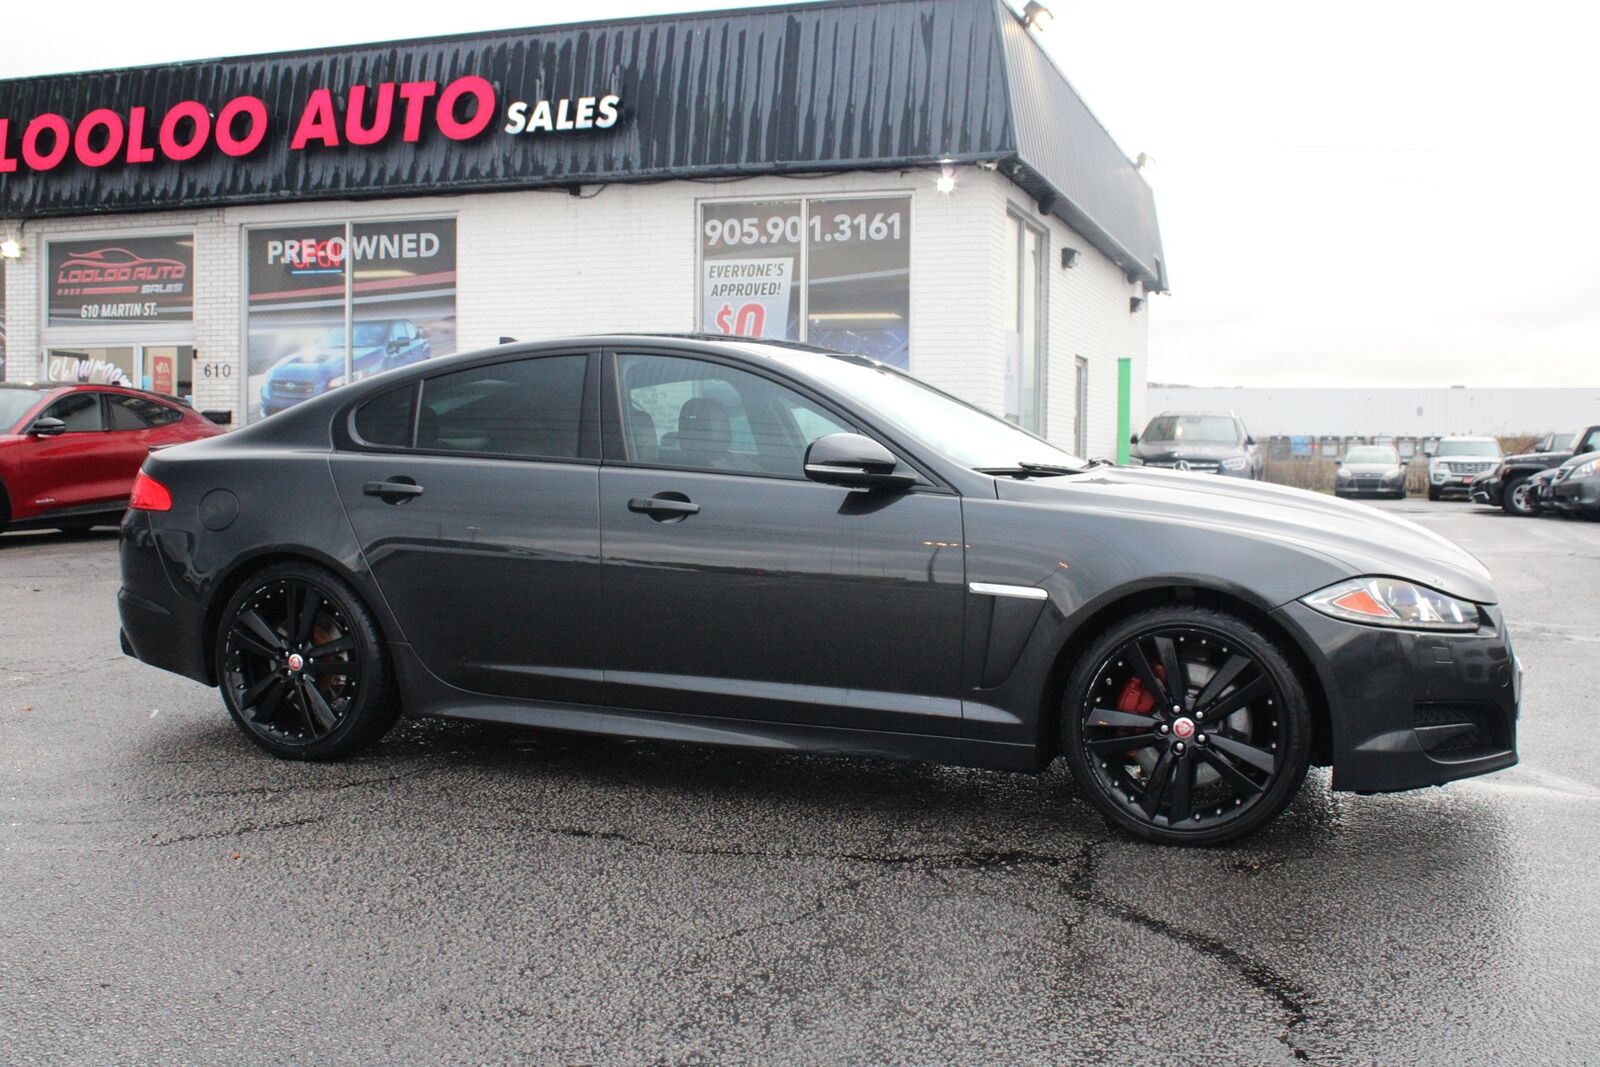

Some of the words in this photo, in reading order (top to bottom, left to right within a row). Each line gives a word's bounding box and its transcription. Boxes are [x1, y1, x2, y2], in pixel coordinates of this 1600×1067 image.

[0, 95, 268, 173] LOOLOO
[290, 75, 496, 150] AUTO
[504, 94, 620, 135] SALES
[704, 212, 901, 246] 905.901.3161
[57, 267, 132, 284] LOOLOO
[132, 265, 186, 280] AUTO
[708, 263, 784, 279] EVERYONE'S
[141, 283, 184, 294] SALES
[710, 282, 782, 297] APPROVED!
[81, 304, 99, 318] 610
[101, 303, 142, 317] MARTIN
[143, 302, 158, 316] ST.
[204, 364, 231, 378] 610
